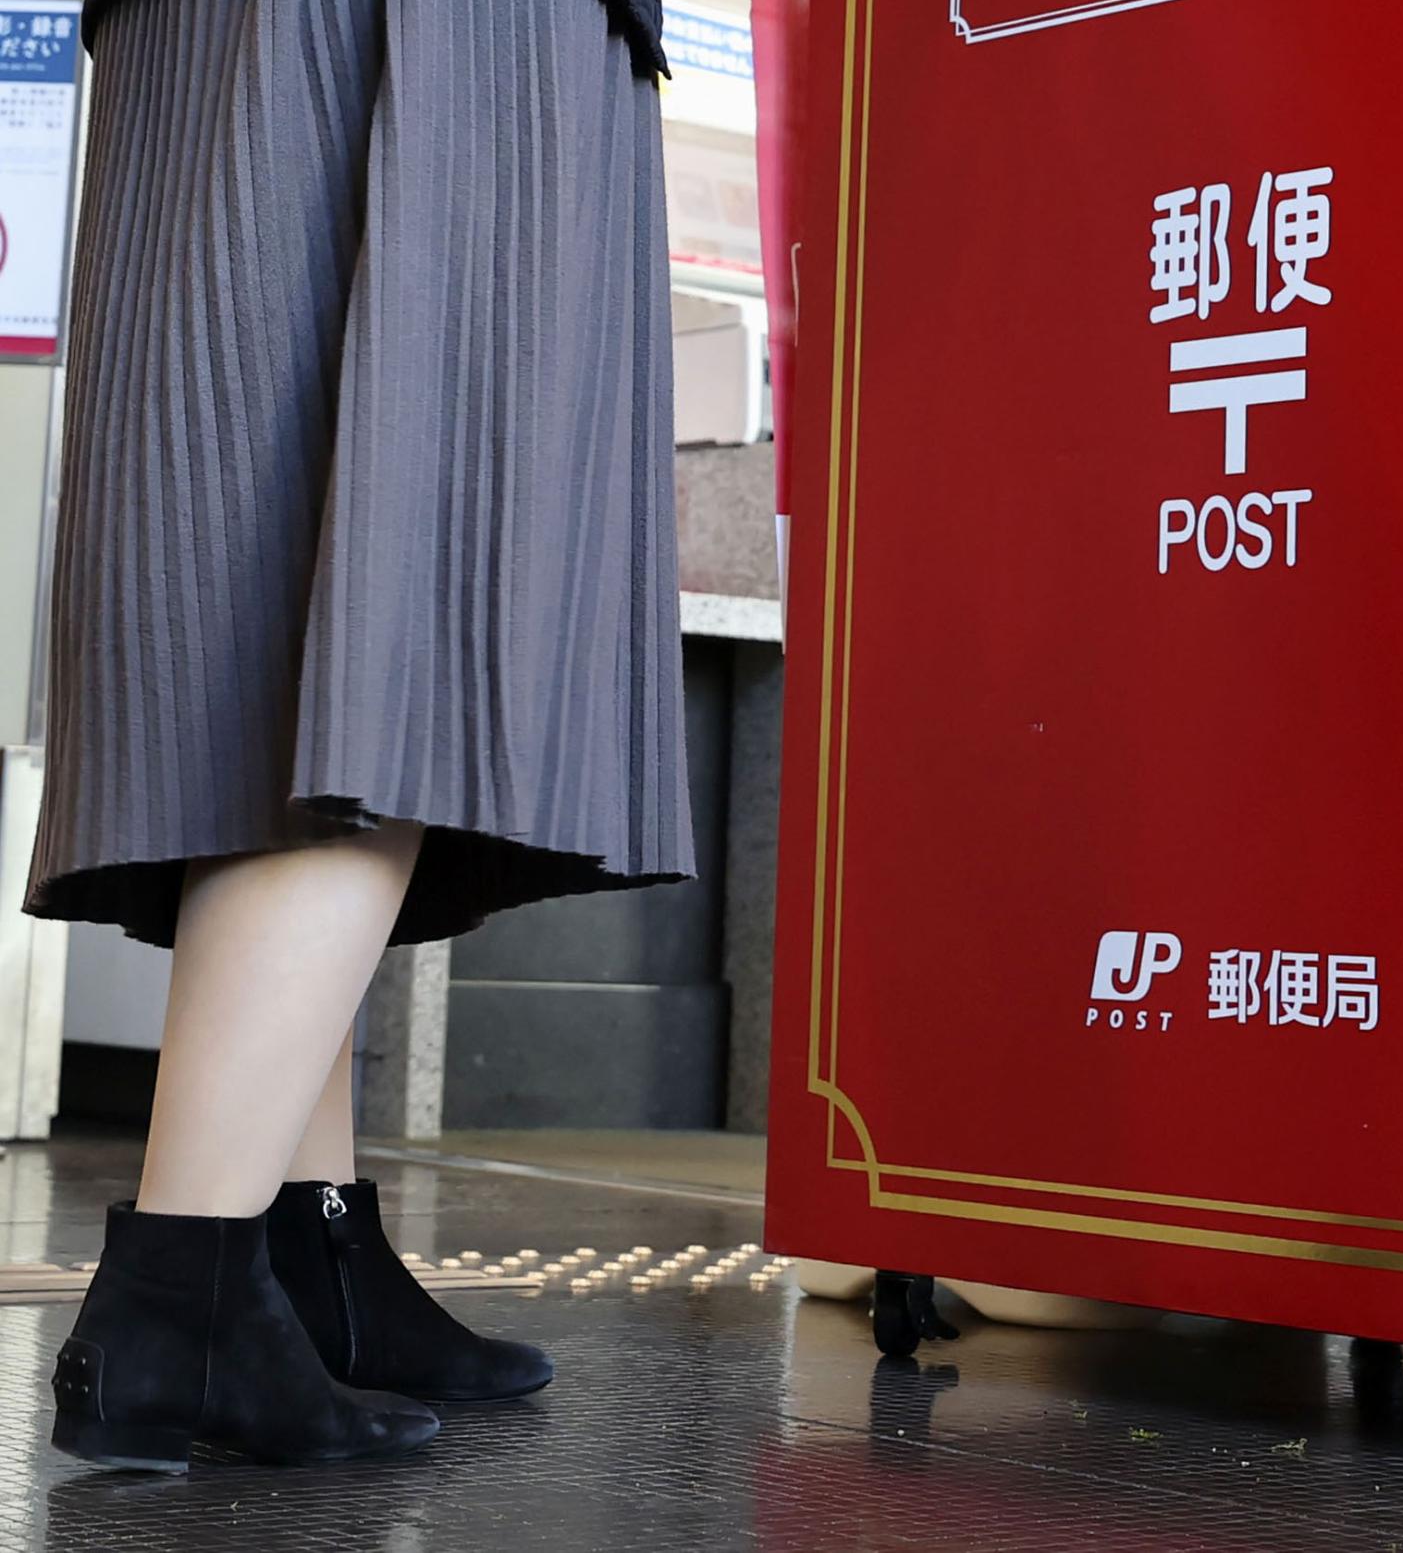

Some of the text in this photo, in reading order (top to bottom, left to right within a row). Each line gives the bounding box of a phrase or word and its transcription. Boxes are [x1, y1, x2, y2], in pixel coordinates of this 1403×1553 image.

[1149, 166, 1334, 324] 郵便
[1158, 489, 1313, 574] POST
[1085, 1007, 1173, 1032] POST
[1207, 948, 1380, 1031] 郵便局
